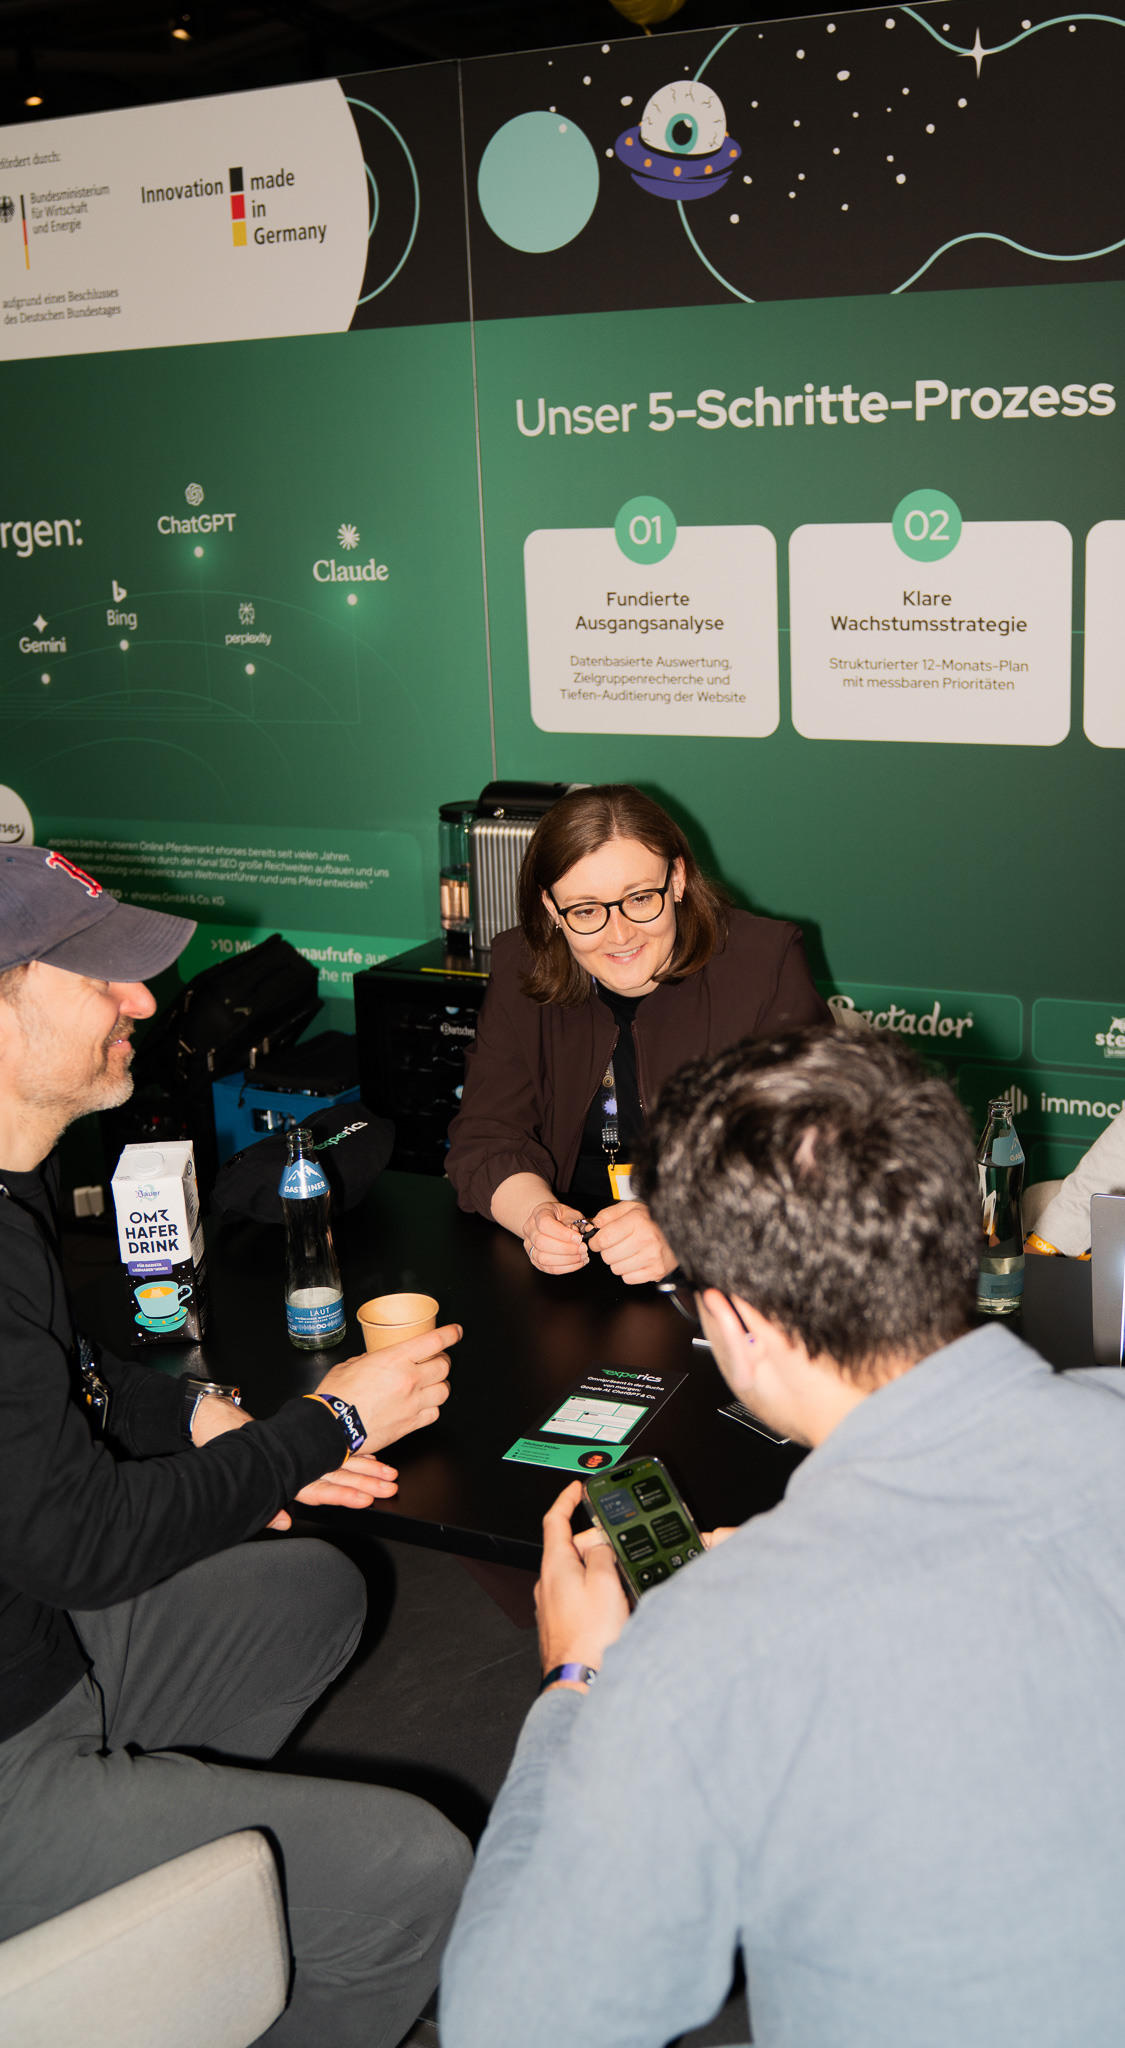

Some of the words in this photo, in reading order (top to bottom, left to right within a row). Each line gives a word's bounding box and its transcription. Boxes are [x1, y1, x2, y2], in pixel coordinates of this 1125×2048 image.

[30, 184, 110, 204] Bundesministerium
[141, 179, 224, 204] Innovation
[250, 168, 295, 191] made
[32, 207, 42, 219] für
[44, 201, 88, 217] Wirtschaft
[252, 200, 266, 218] in
[32, 222, 48, 234] und
[50, 218, 82, 233] Energie
[254, 225, 327, 246] Germany
[3, 294, 42, 310] aufgrund
[44, 293, 66, 304] eines
[68, 288, 119, 302] Beschlusses
[4, 314, 18, 324] des
[20, 309, 65, 323] Deutschen
[67, 305, 121, 318] Bundestages
[516, 398, 638, 437] Unser
[648, 379, 1116, 431] 5-Schritte-Prozess
[157, 513, 236, 535] ChatGPT
[628, 515, 662, 545] 01
[904, 509, 950, 541] 02
[0, 518, 84, 558] rgen:
[312, 558, 390, 582] Claude
[606, 591, 690, 606] Fundierte
[903, 590, 952, 606] Klare
[106, 609, 138, 630] Bing
[576, 615, 724, 634] Ausgangsanalyse
[830, 616, 1028, 636] Wachstumsstrategie
[19, 637, 67, 653] Gemini
[225, 632, 272, 646] perplexity
[570, 656, 654, 667] Datenbasierte
[656, 656, 732, 670] Auswertung,
[829, 658, 919, 670] Strukturierter
[922, 659, 1029, 672] 12-Monats-Plan
[573, 672, 704, 686] Zielgruppenrecherche
[706, 674, 730, 685] und
[842, 676, 864, 688] mit
[867, 676, 940, 689] messbaren
[942, 677, 1015, 690] Prioritäten
[560, 688, 671, 704] Tiefen-Auditierung
[674, 691, 694, 702] der
[697, 692, 746, 703] Website
[0, 824, 20, 834] ses
[108, 840, 138, 849] unseren
[139, 841, 164, 850] Online
[166, 842, 214, 854] Pferdemarkt
[216, 846, 247, 856] ehorses
[248, 848, 276, 858] bereits
[278, 850, 292, 858] seit
[294, 850, 318, 860] vielen
[320, 852, 350, 862] Jahren.
[106, 854, 156, 863] insbesondere
[158, 856, 180, 865] durch
[181, 856, 196, 865] den
[197, 856, 218, 867] Kanal
[219, 858, 238, 869] SEO
[238, 860, 262, 871] große
[264, 860, 314, 874] Reichweiten
[315, 864, 354, 876] aufbauen
[356, 866, 372, 877] und
[374, 868, 390, 878] uns
[176, 870, 193, 878] zum
[194, 870, 258, 883] Weltmarktführer
[260, 874, 278, 884] rund
[280, 876, 297, 885] ums
[298, 876, 322, 888] Pferd
[212, 896, 225, 906] KG
[211, 938, 233, 953] >10
[296, 946, 362, 964] naufrufe
[1042, 1092, 1125, 1119] immoc
[135, 1188, 160, 1198] Bauer
[125, 1224, 178, 1240] HAFER
[128, 1238, 180, 1254] DRINK
[310, 1307, 330, 1316] LAUT
[603, 1368, 662, 1382] experics
